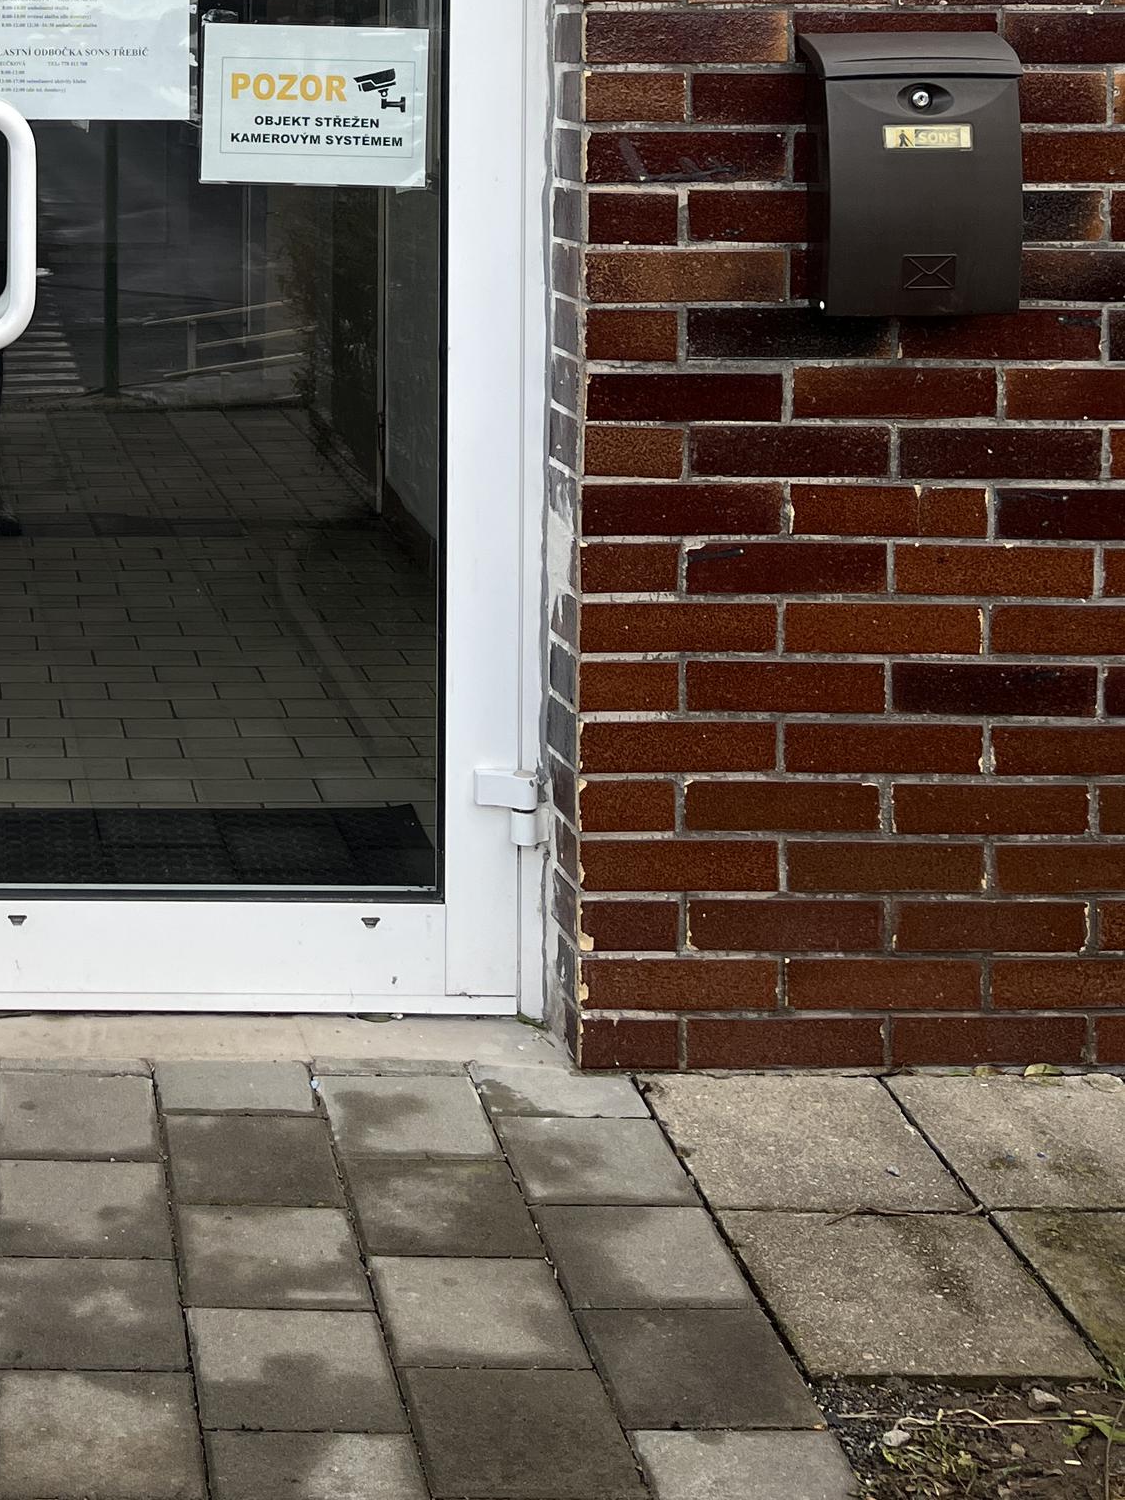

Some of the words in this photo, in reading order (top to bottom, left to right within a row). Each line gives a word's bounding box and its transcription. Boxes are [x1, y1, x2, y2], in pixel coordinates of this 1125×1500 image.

[33, 46, 83, 58] ODBOČKA
[84, 48, 111, 58] SONS
[112, 47, 150, 58] TŘEBÍČ
[230, 72, 348, 103] POZOR
[254, 115, 311, 129] OBJEKT
[313, 114, 381, 130] STŘEŽEN
[230, 129, 322, 147] KAMEROVÝM
[324, 132, 404, 148] SYSTÉMEM
[917, 131, 958, 144] SONS
